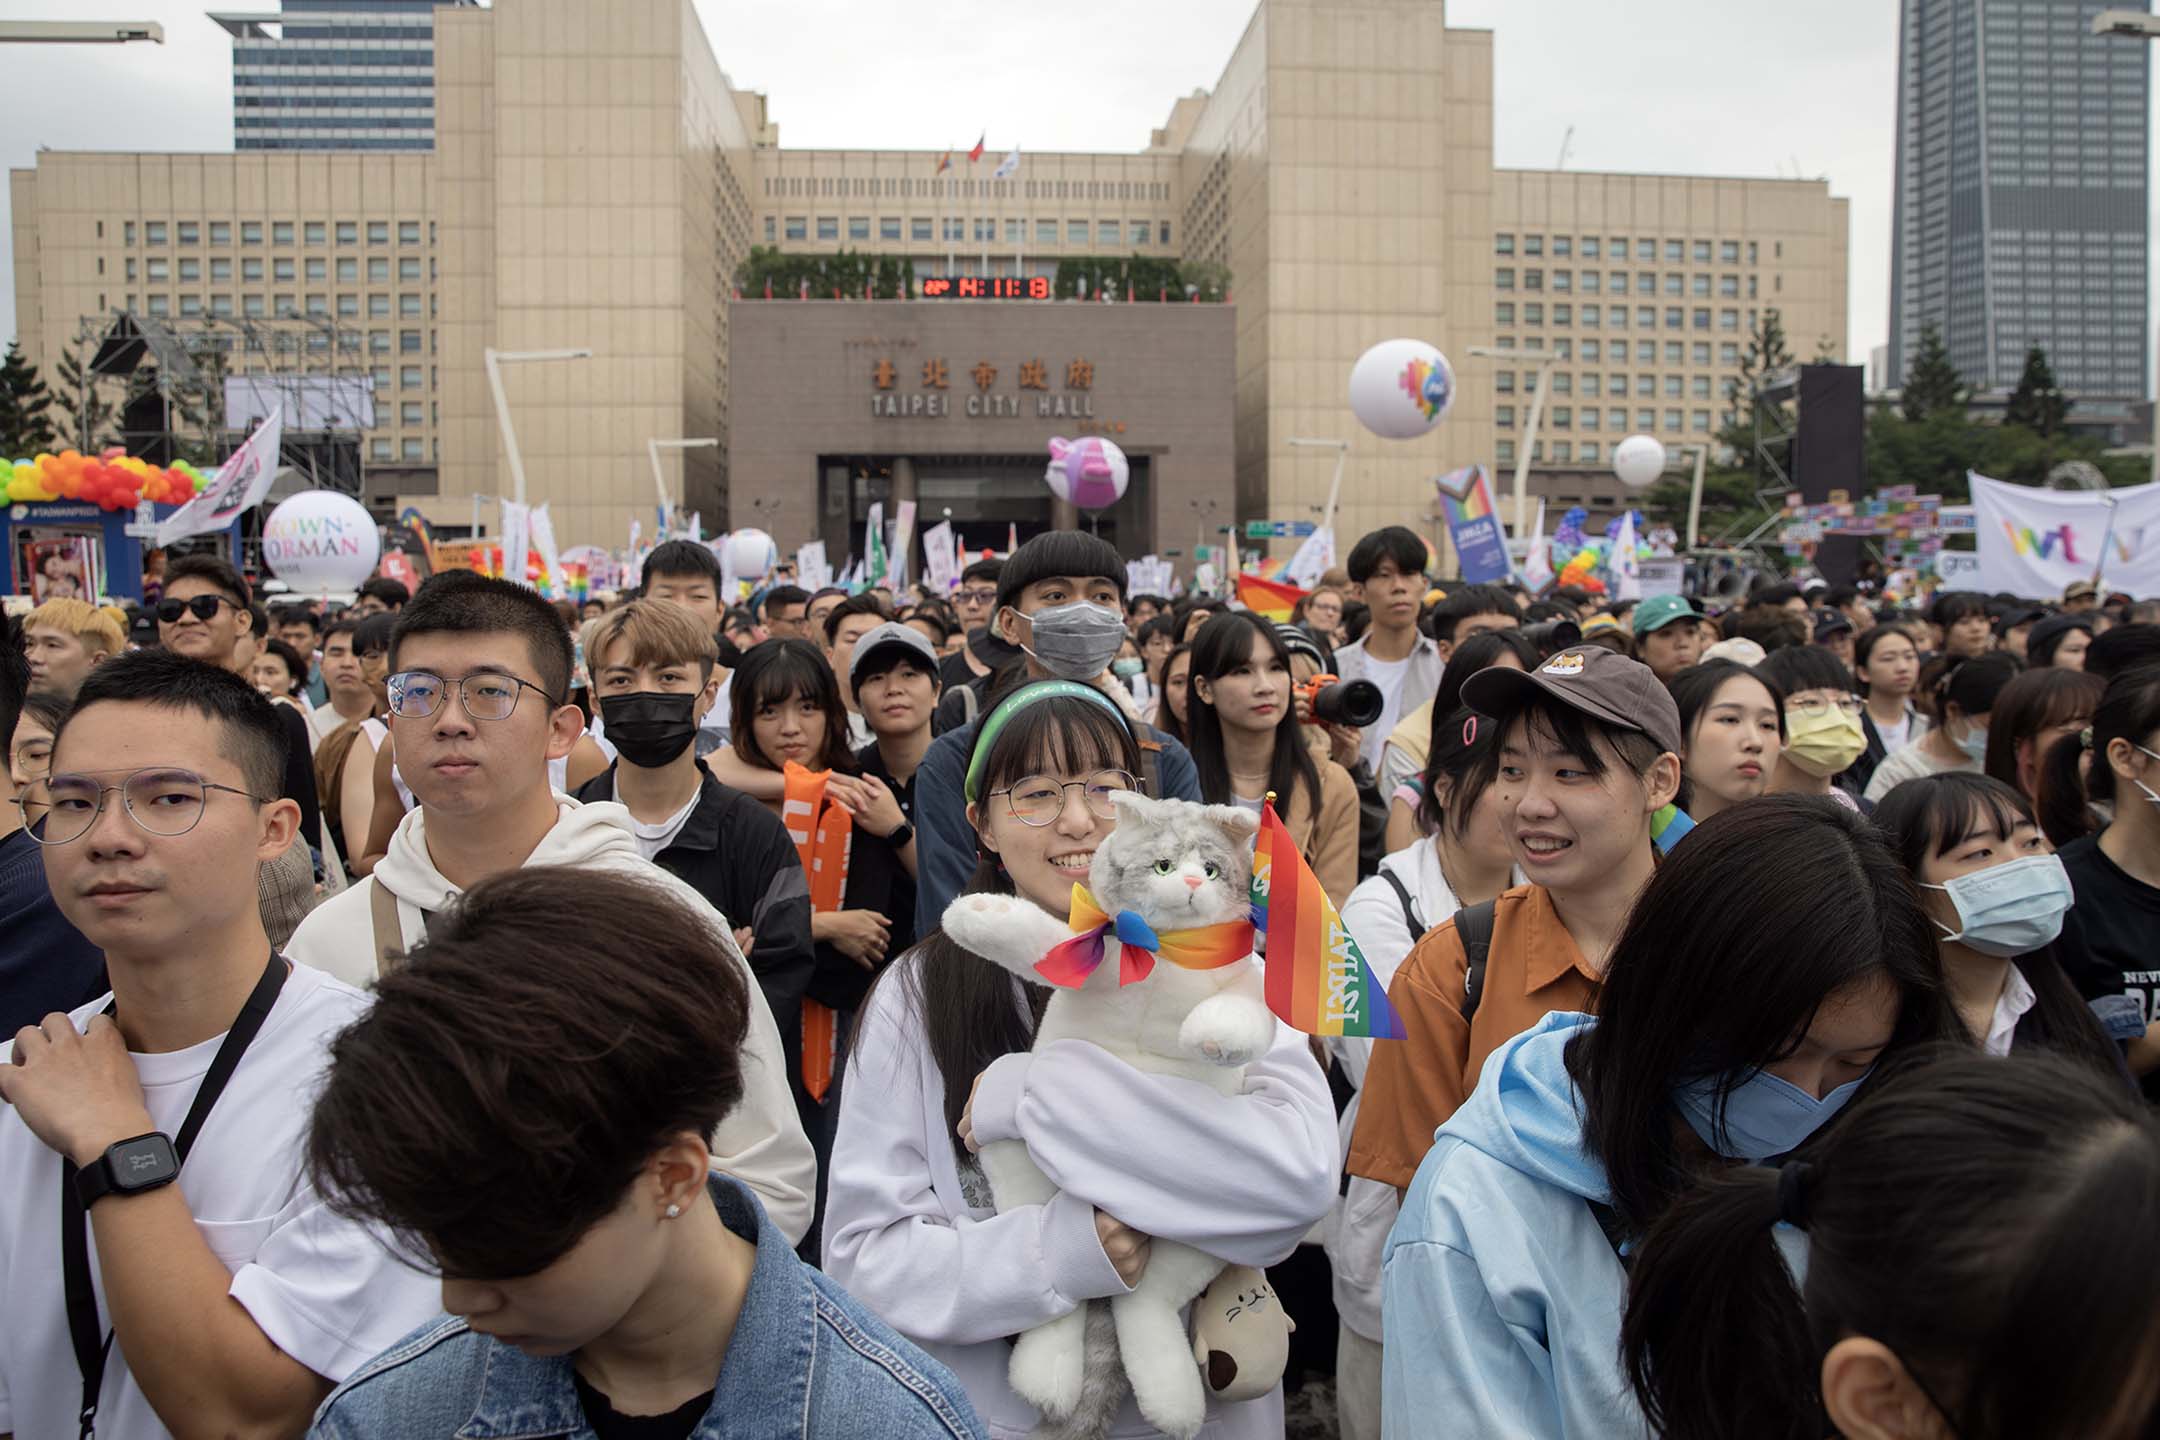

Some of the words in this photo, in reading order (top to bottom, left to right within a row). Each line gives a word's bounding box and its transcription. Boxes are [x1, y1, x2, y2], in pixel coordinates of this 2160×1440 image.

[874, 356, 1095, 392] 臺北市政府
[873, 395, 950, 417] TAIPEI
[966, 395, 1021, 417] CITY
[1037, 395, 1096, 417] HALL
